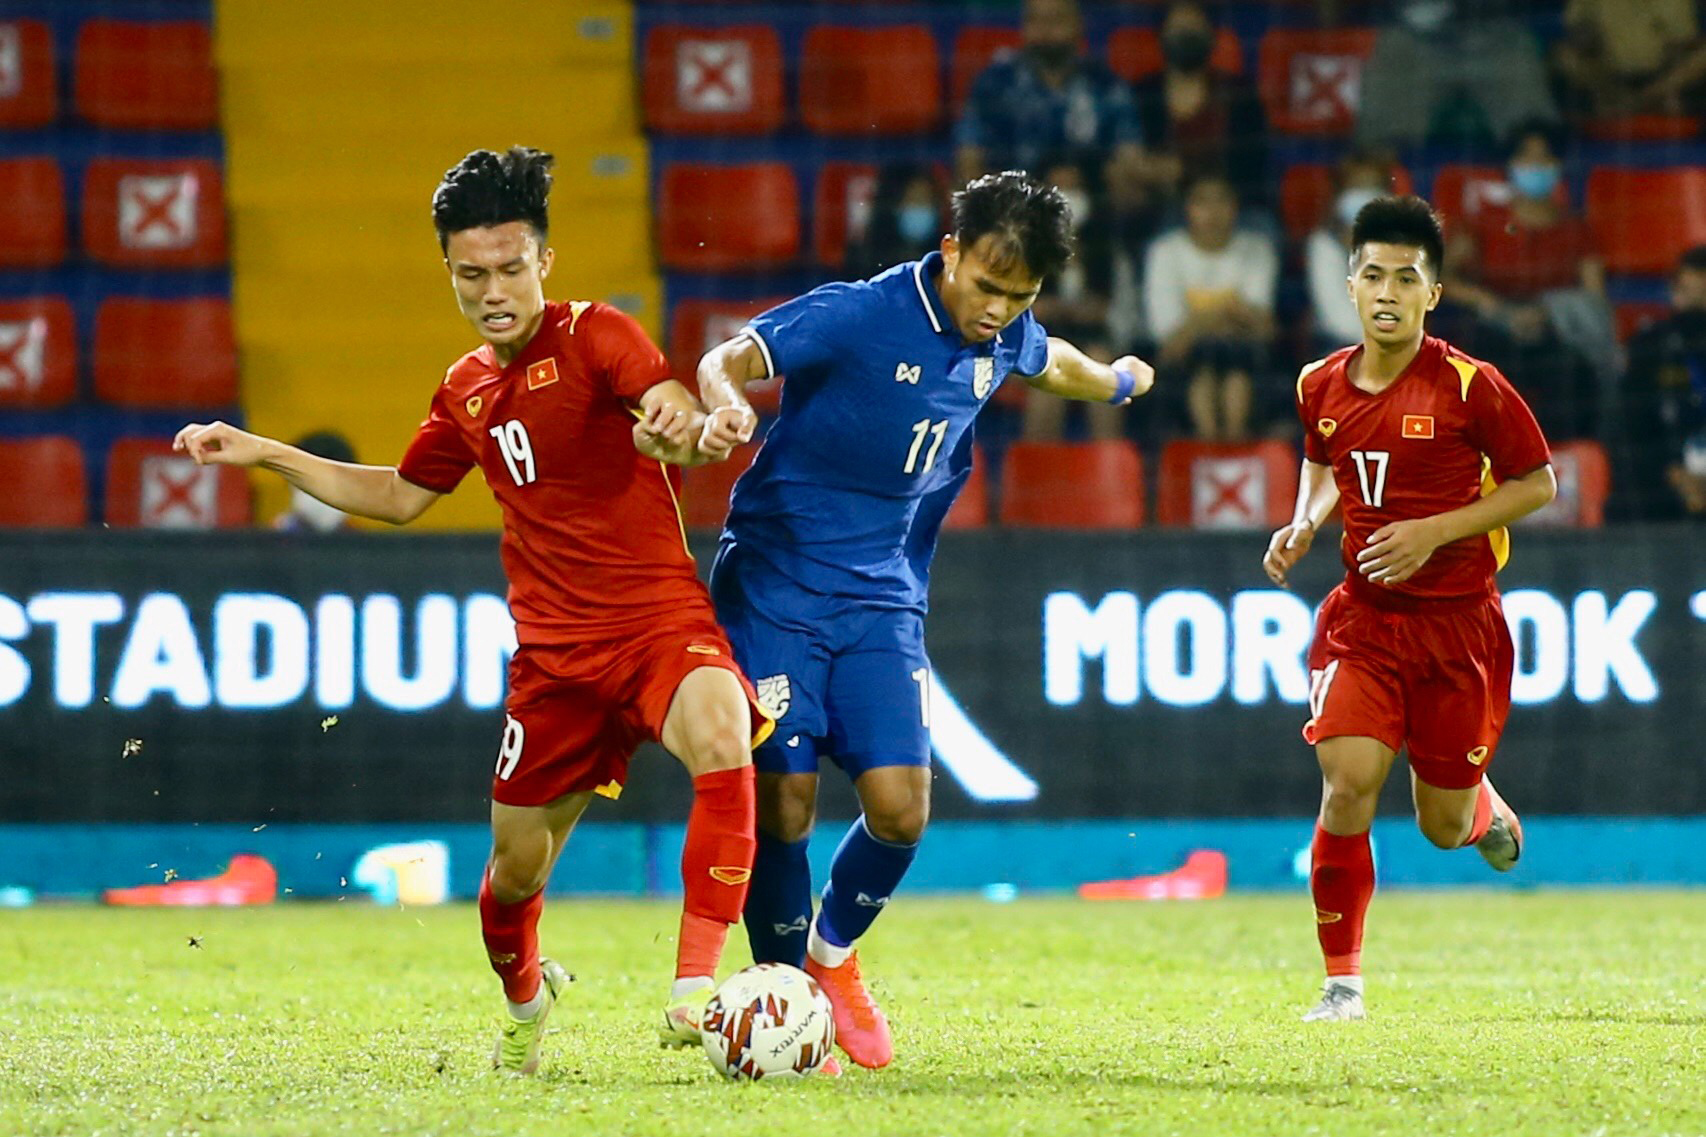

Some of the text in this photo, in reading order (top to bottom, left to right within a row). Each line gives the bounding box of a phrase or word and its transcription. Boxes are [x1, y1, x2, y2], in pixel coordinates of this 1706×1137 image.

[489, 419, 536, 486] 19
[904, 418, 948, 473] 11
[1350, 451, 1389, 507] 17
[1044, 589, 1659, 704] MOROK
[769, 1010, 817, 1058] WARRIX
